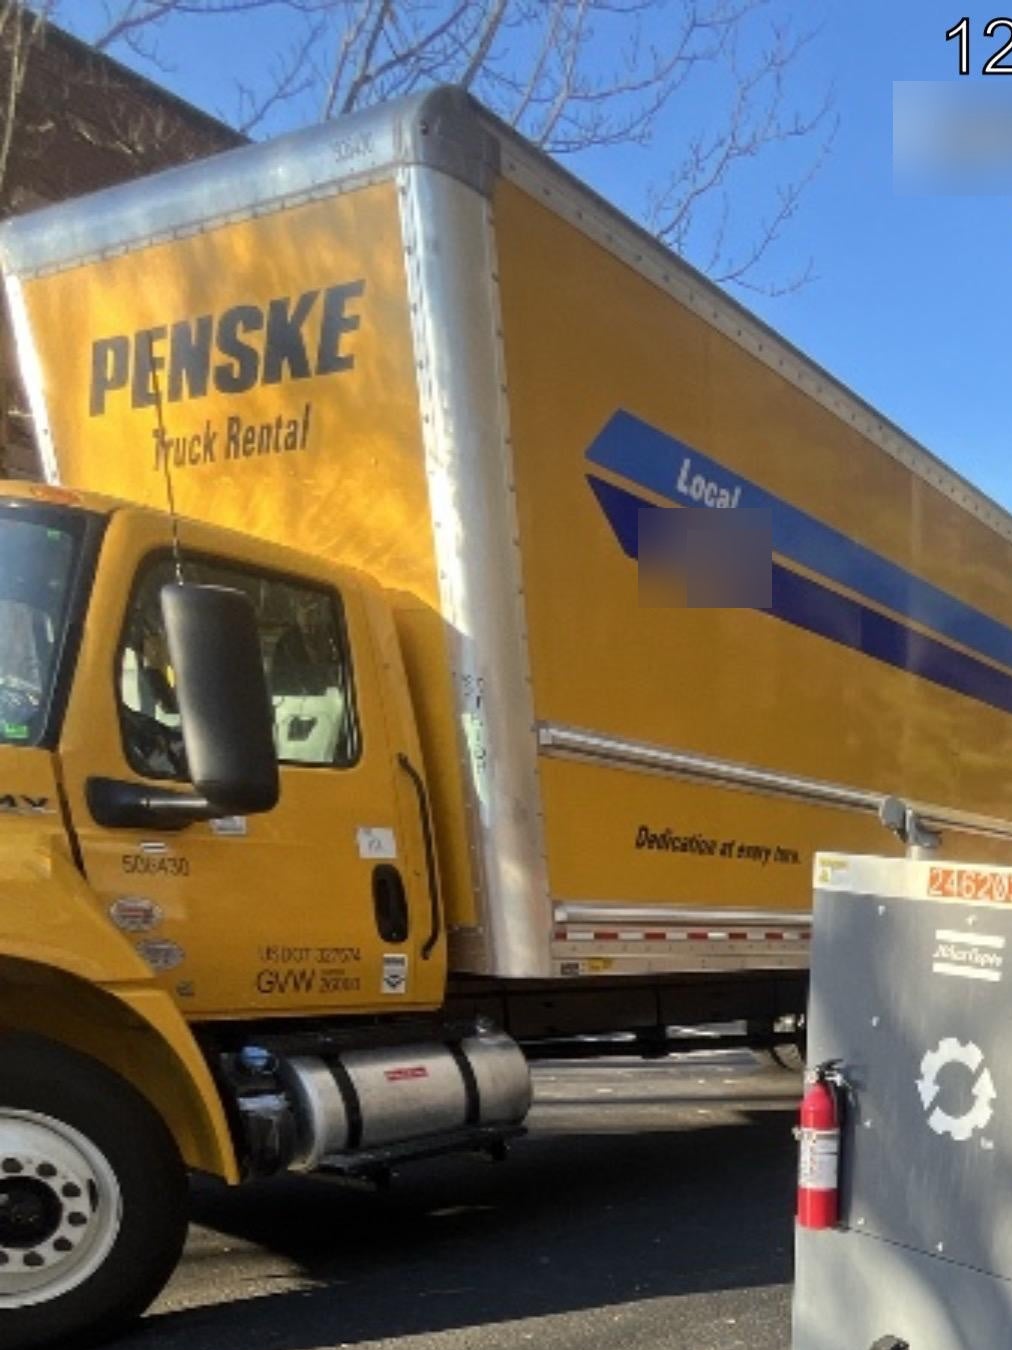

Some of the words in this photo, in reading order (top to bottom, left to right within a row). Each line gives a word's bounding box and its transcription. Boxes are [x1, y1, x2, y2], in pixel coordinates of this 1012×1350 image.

[89, 279, 366, 417] PENSKE
[151, 419, 217, 471] Truck
[224, 402, 312, 460] Rental
[677, 458, 741, 508] Local
[634, 824, 717, 856] Dedication
[719, 840, 735, 859] at
[257, 968, 315, 994] GVW
